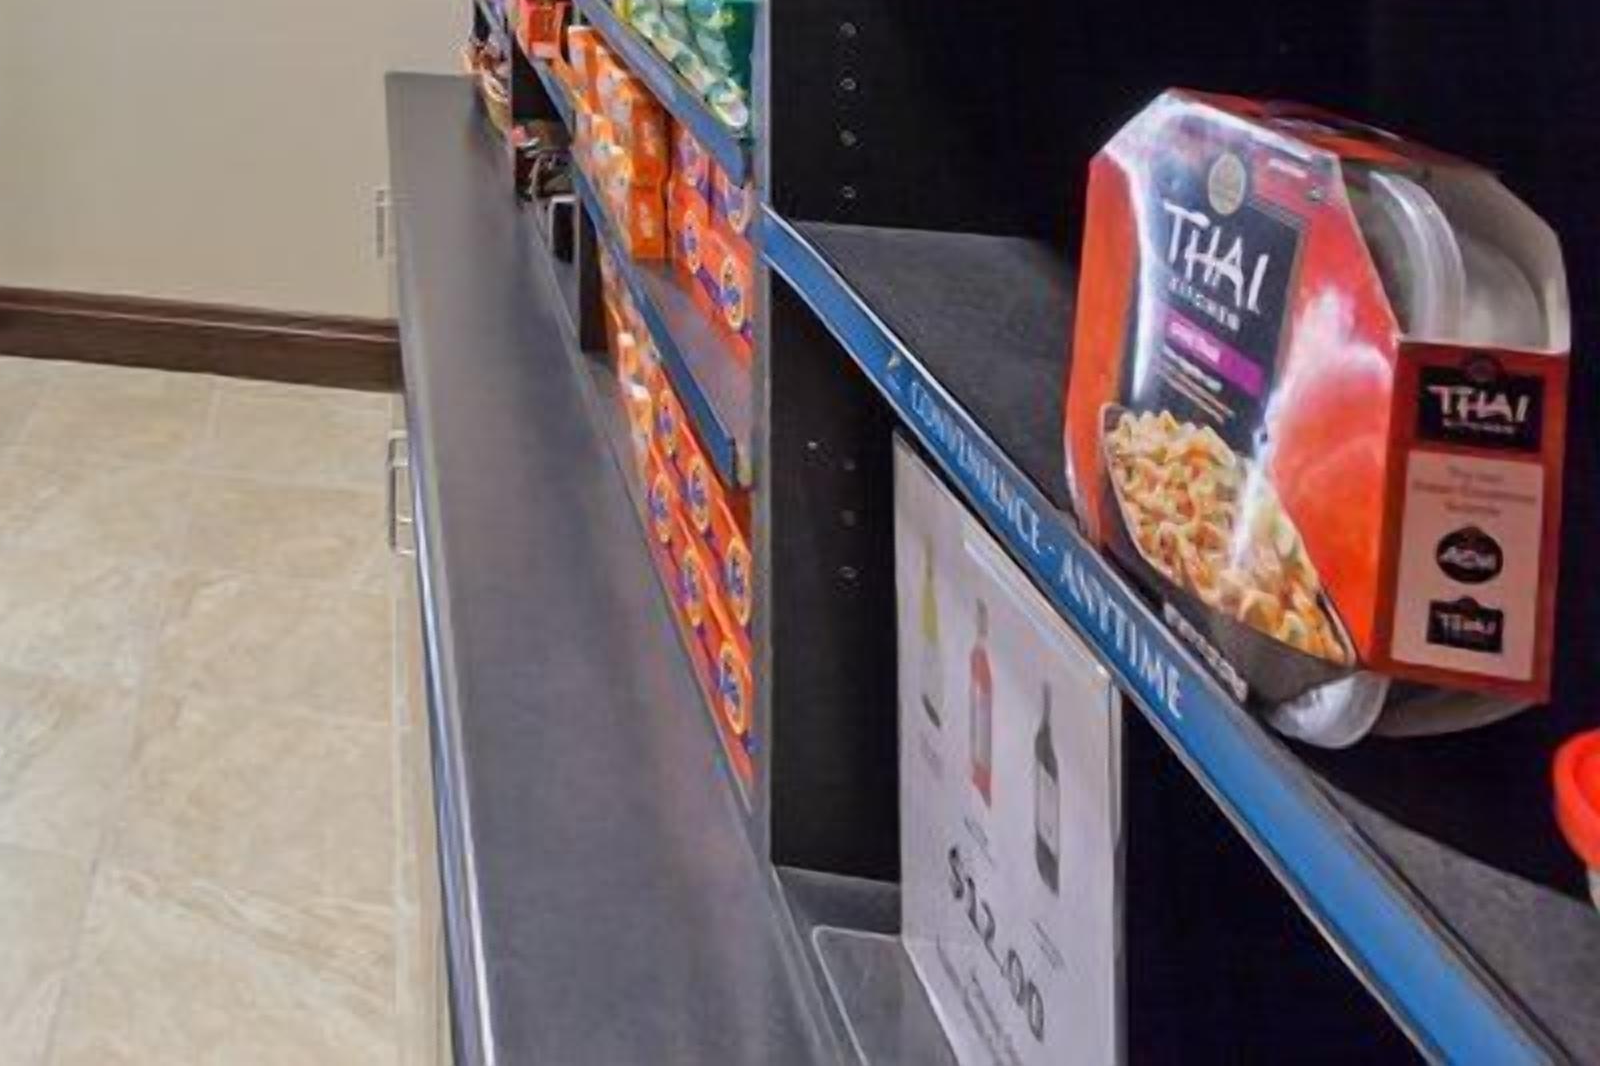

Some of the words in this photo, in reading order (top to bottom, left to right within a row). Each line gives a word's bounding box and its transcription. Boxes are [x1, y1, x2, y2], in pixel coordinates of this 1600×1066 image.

[1163, 199, 1270, 314] THAI
[1428, 385, 1530, 423] THAI
[1059, 551, 1183, 720] ANYTIME
